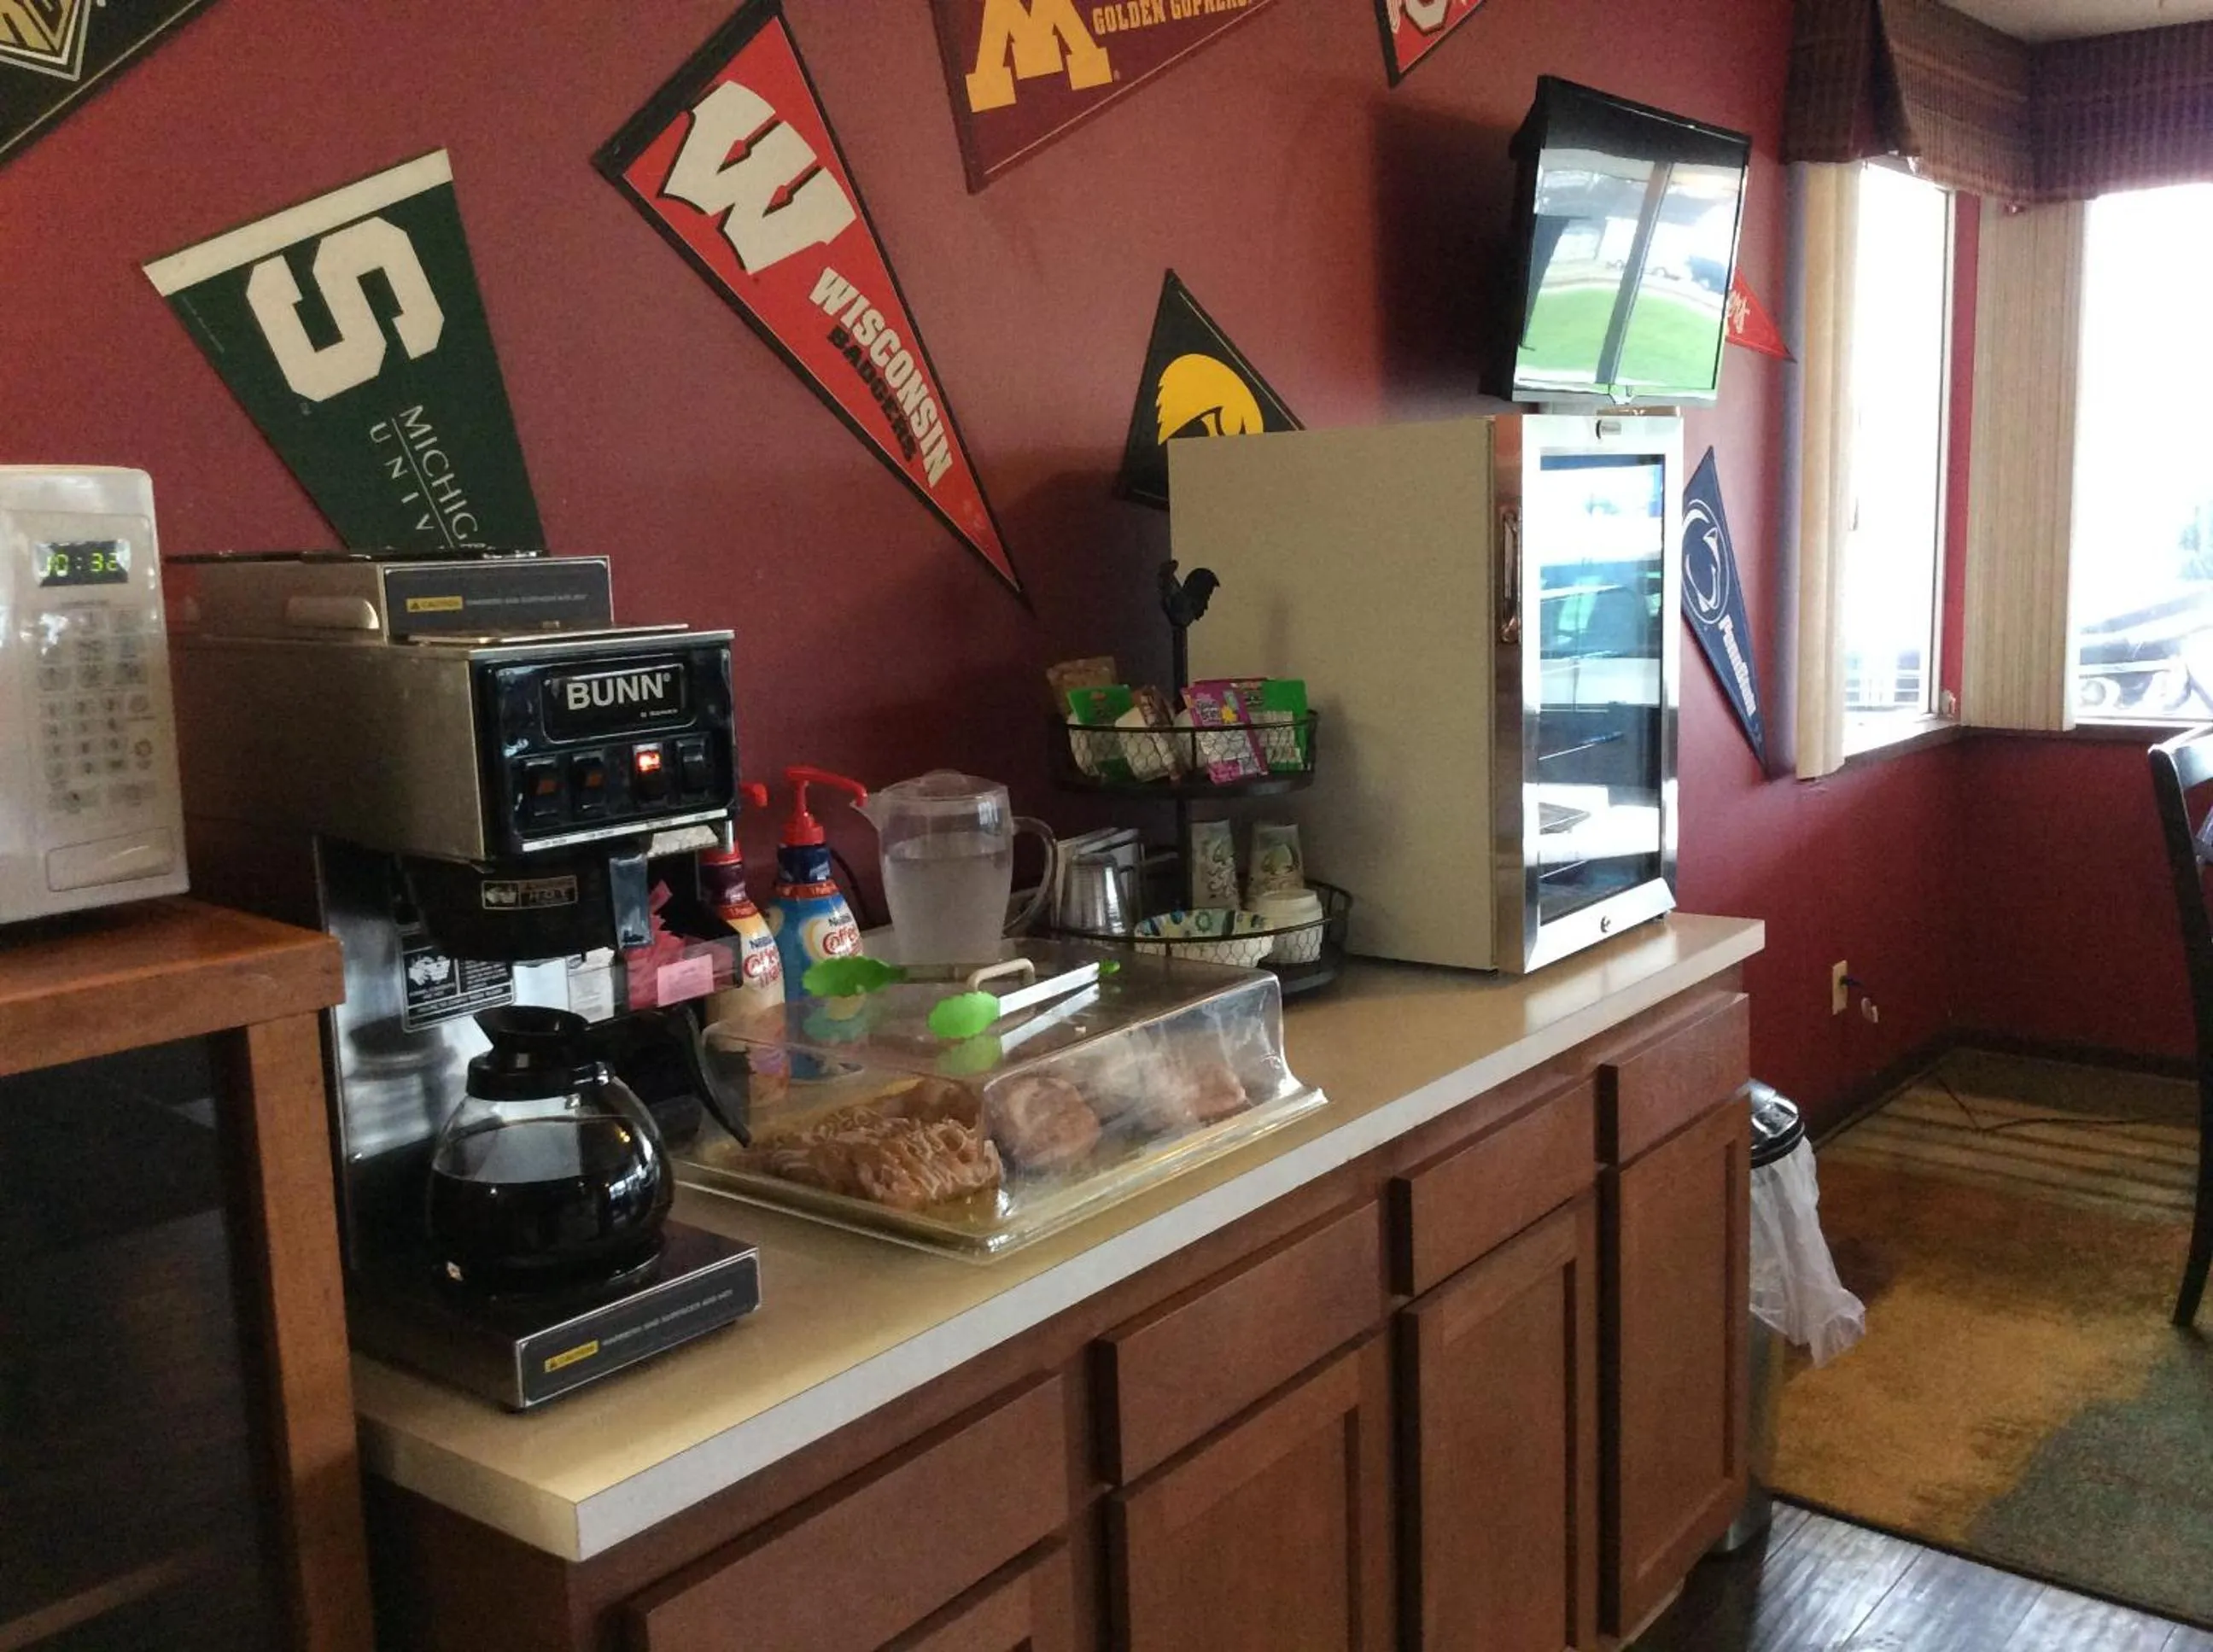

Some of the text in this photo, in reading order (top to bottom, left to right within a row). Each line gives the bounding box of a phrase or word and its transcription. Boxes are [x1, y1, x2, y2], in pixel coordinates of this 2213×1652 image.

[966, 0, 1113, 113] M
[1092, 0, 1166, 35] GOLDEN
[660, 80, 857, 276] W
[246, 216, 445, 402] S
[809, 266, 954, 488] WISCONSIN
[399, 405, 484, 548] MICHIG
